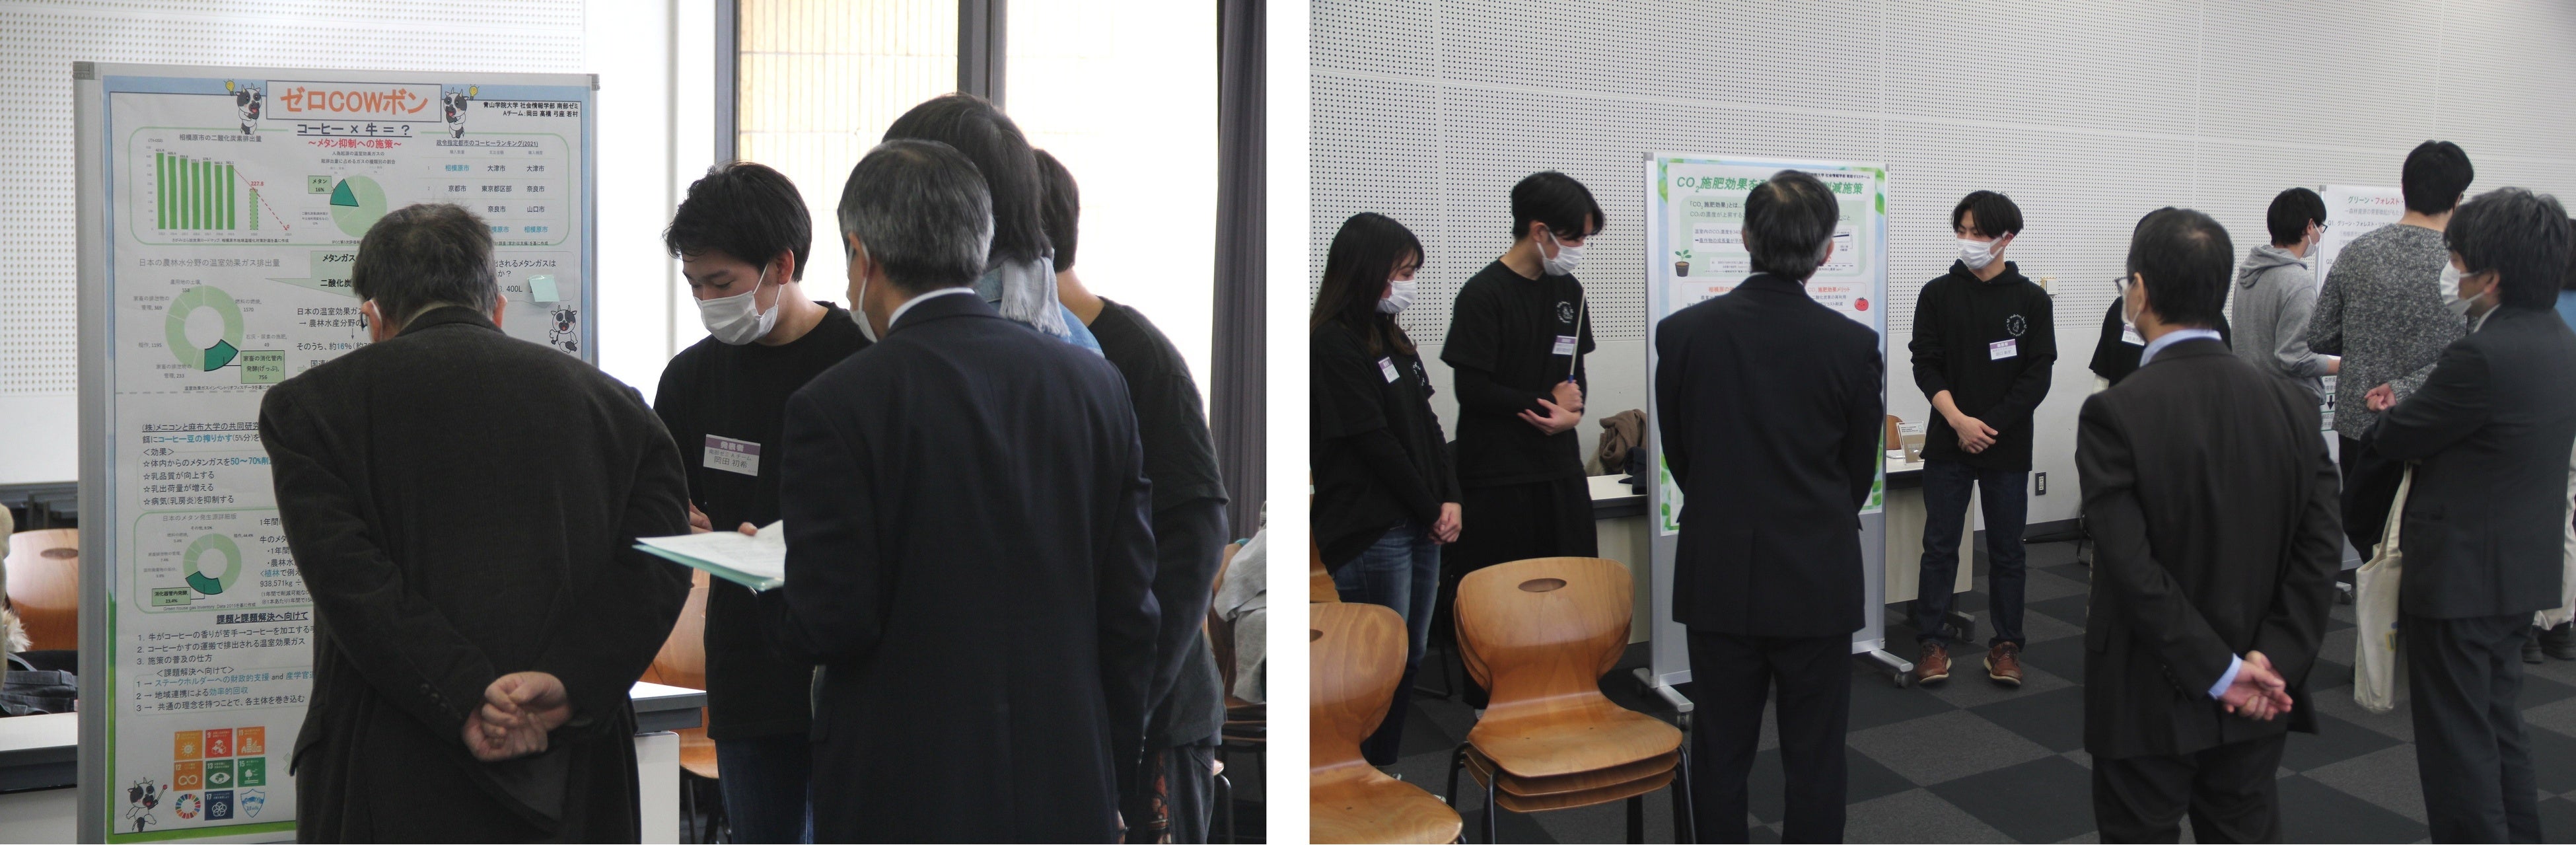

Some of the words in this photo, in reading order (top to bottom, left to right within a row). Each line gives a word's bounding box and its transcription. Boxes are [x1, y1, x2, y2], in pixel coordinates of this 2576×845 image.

[280, 86, 429, 115] ゼロCOWボン
[297, 123, 344, 135] コーヒー
[365, 122, 378, 136] 牛
[139, 258, 280, 267] 日本の農林水分野の温室効果ガス排出量
[322, 254, 355, 262] メタンガス
[320, 278, 354, 287] 二酸化炭
[309, 319, 368, 328] 農林水産分野の
[714, 456, 730, 466] 岡田
[267, 559, 297, 568] ・農林水
[216, 611, 309, 624] 課題と課題解決へ向けて
[147, 638, 306, 653] コーヒーかすの運搬で排出される温室効果ガス
[147, 653, 213, 665] 施策の普及の仕方
[155, 672, 269, 687] ステークホルダーへの財政的支援
[155, 686, 248, 699] 地域連携による効率的回収
